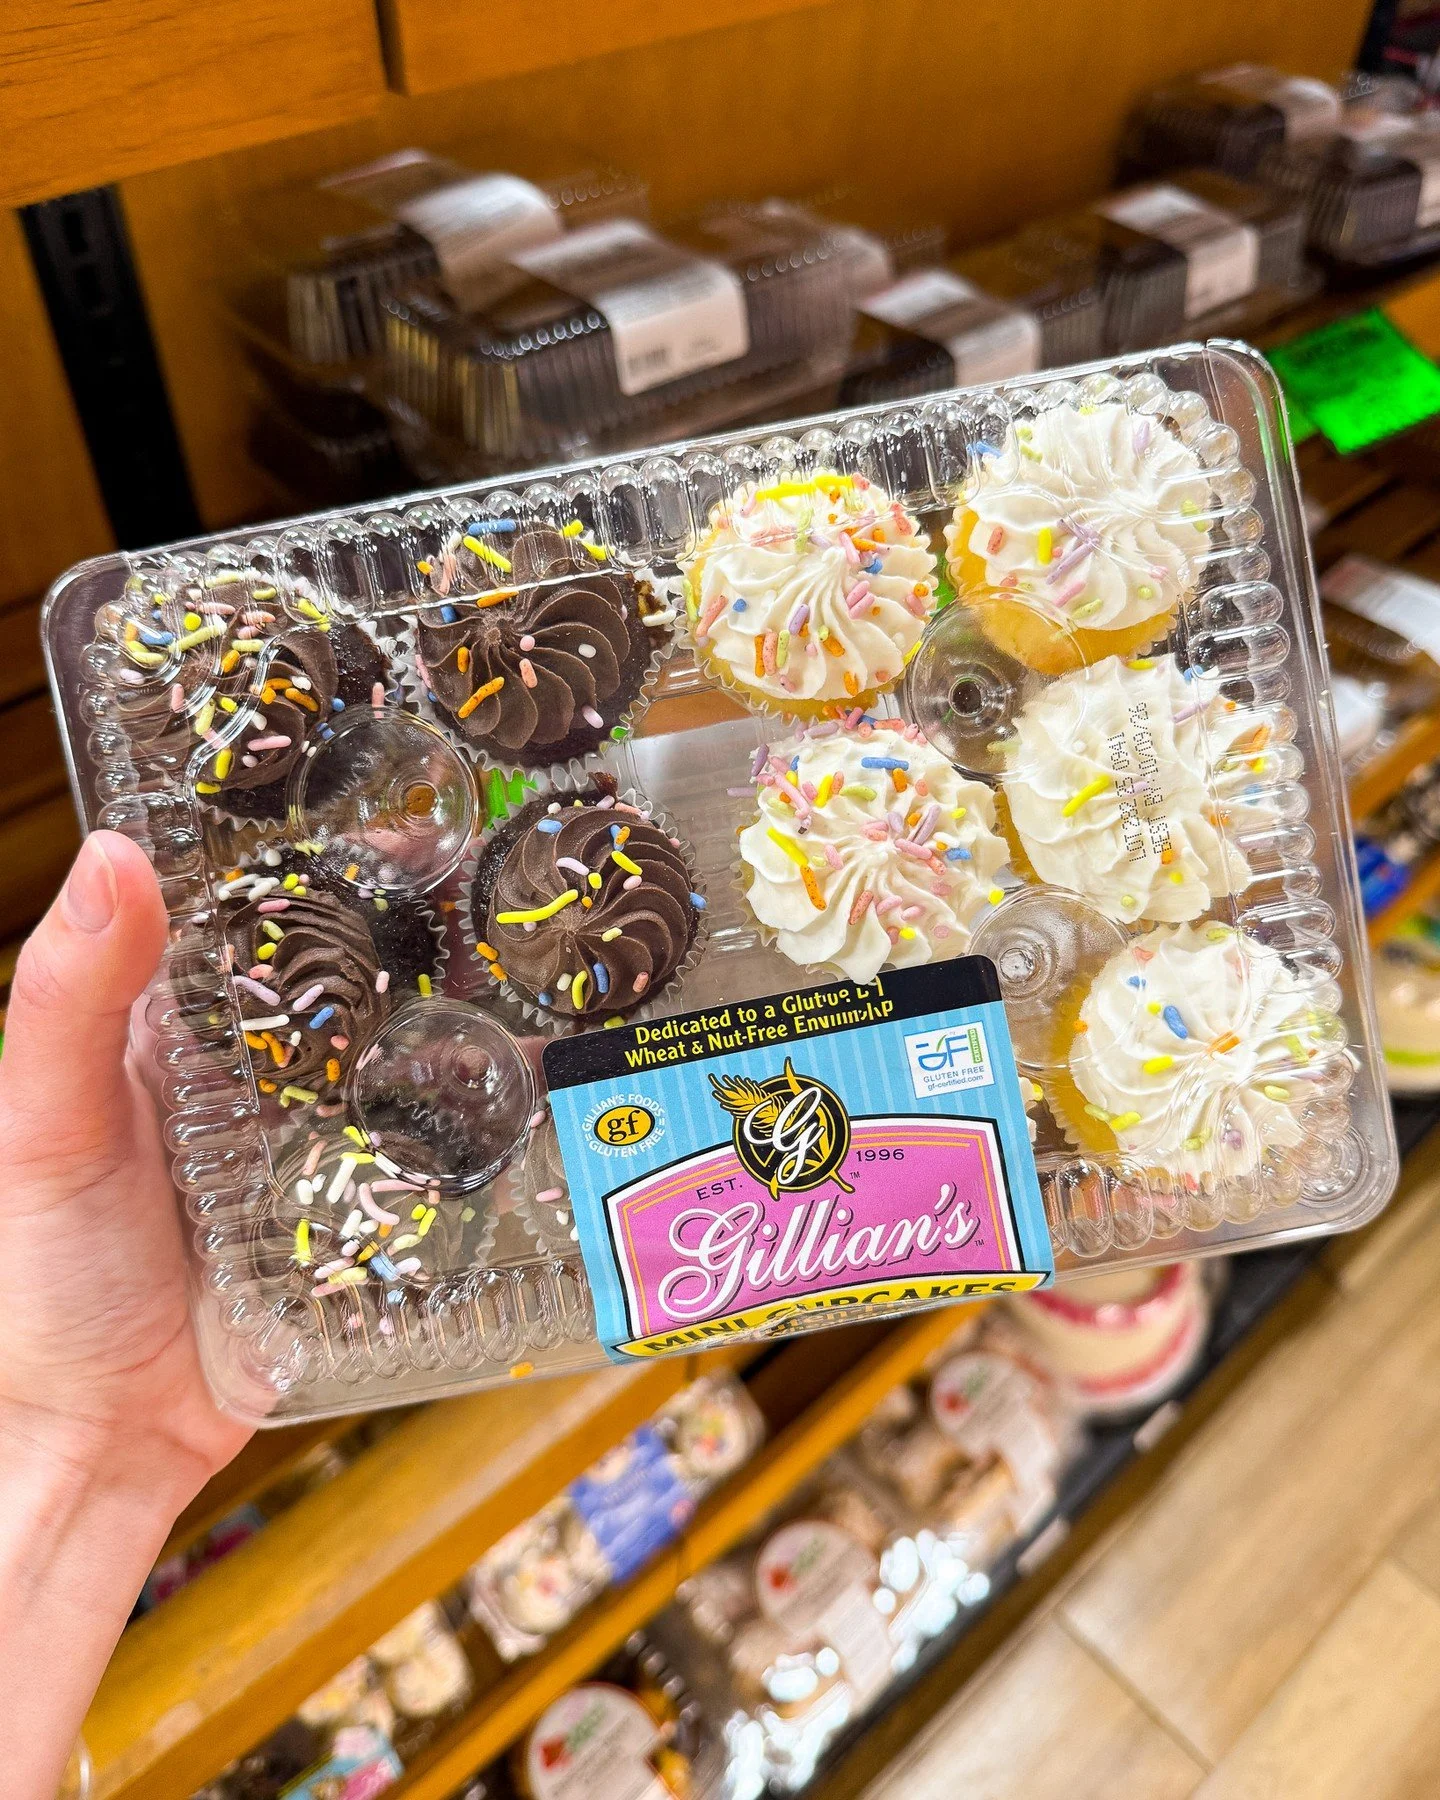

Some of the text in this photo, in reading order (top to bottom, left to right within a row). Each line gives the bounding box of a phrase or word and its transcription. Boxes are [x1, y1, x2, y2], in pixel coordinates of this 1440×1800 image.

[1108, 732, 1129, 770] 0941
[1116, 776, 1135, 797] 25
[1124, 833, 1146, 862] LOT
[1148, 816, 1171, 854] BEST
[635, 1009, 731, 1044] Dedicated
[737, 1007, 757, 1023] to
[764, 1004, 776, 1019] a
[625, 1022, 788, 1068] Wheat & Nut-Free
[923, 1065, 985, 1083] GLUTEN FREE
[927, 1075, 984, 1091] gf-certified.com
[582, 1093, 666, 1132] GILLIAN'S FOODS
[607, 1109, 641, 1142] gf
[588, 1127, 666, 1158] GLUTEN FREE
[696, 1148, 905, 1200] EST. 1996
[658, 1183, 978, 1323] Gillian's
[643, 1317, 749, 1351] MINI
